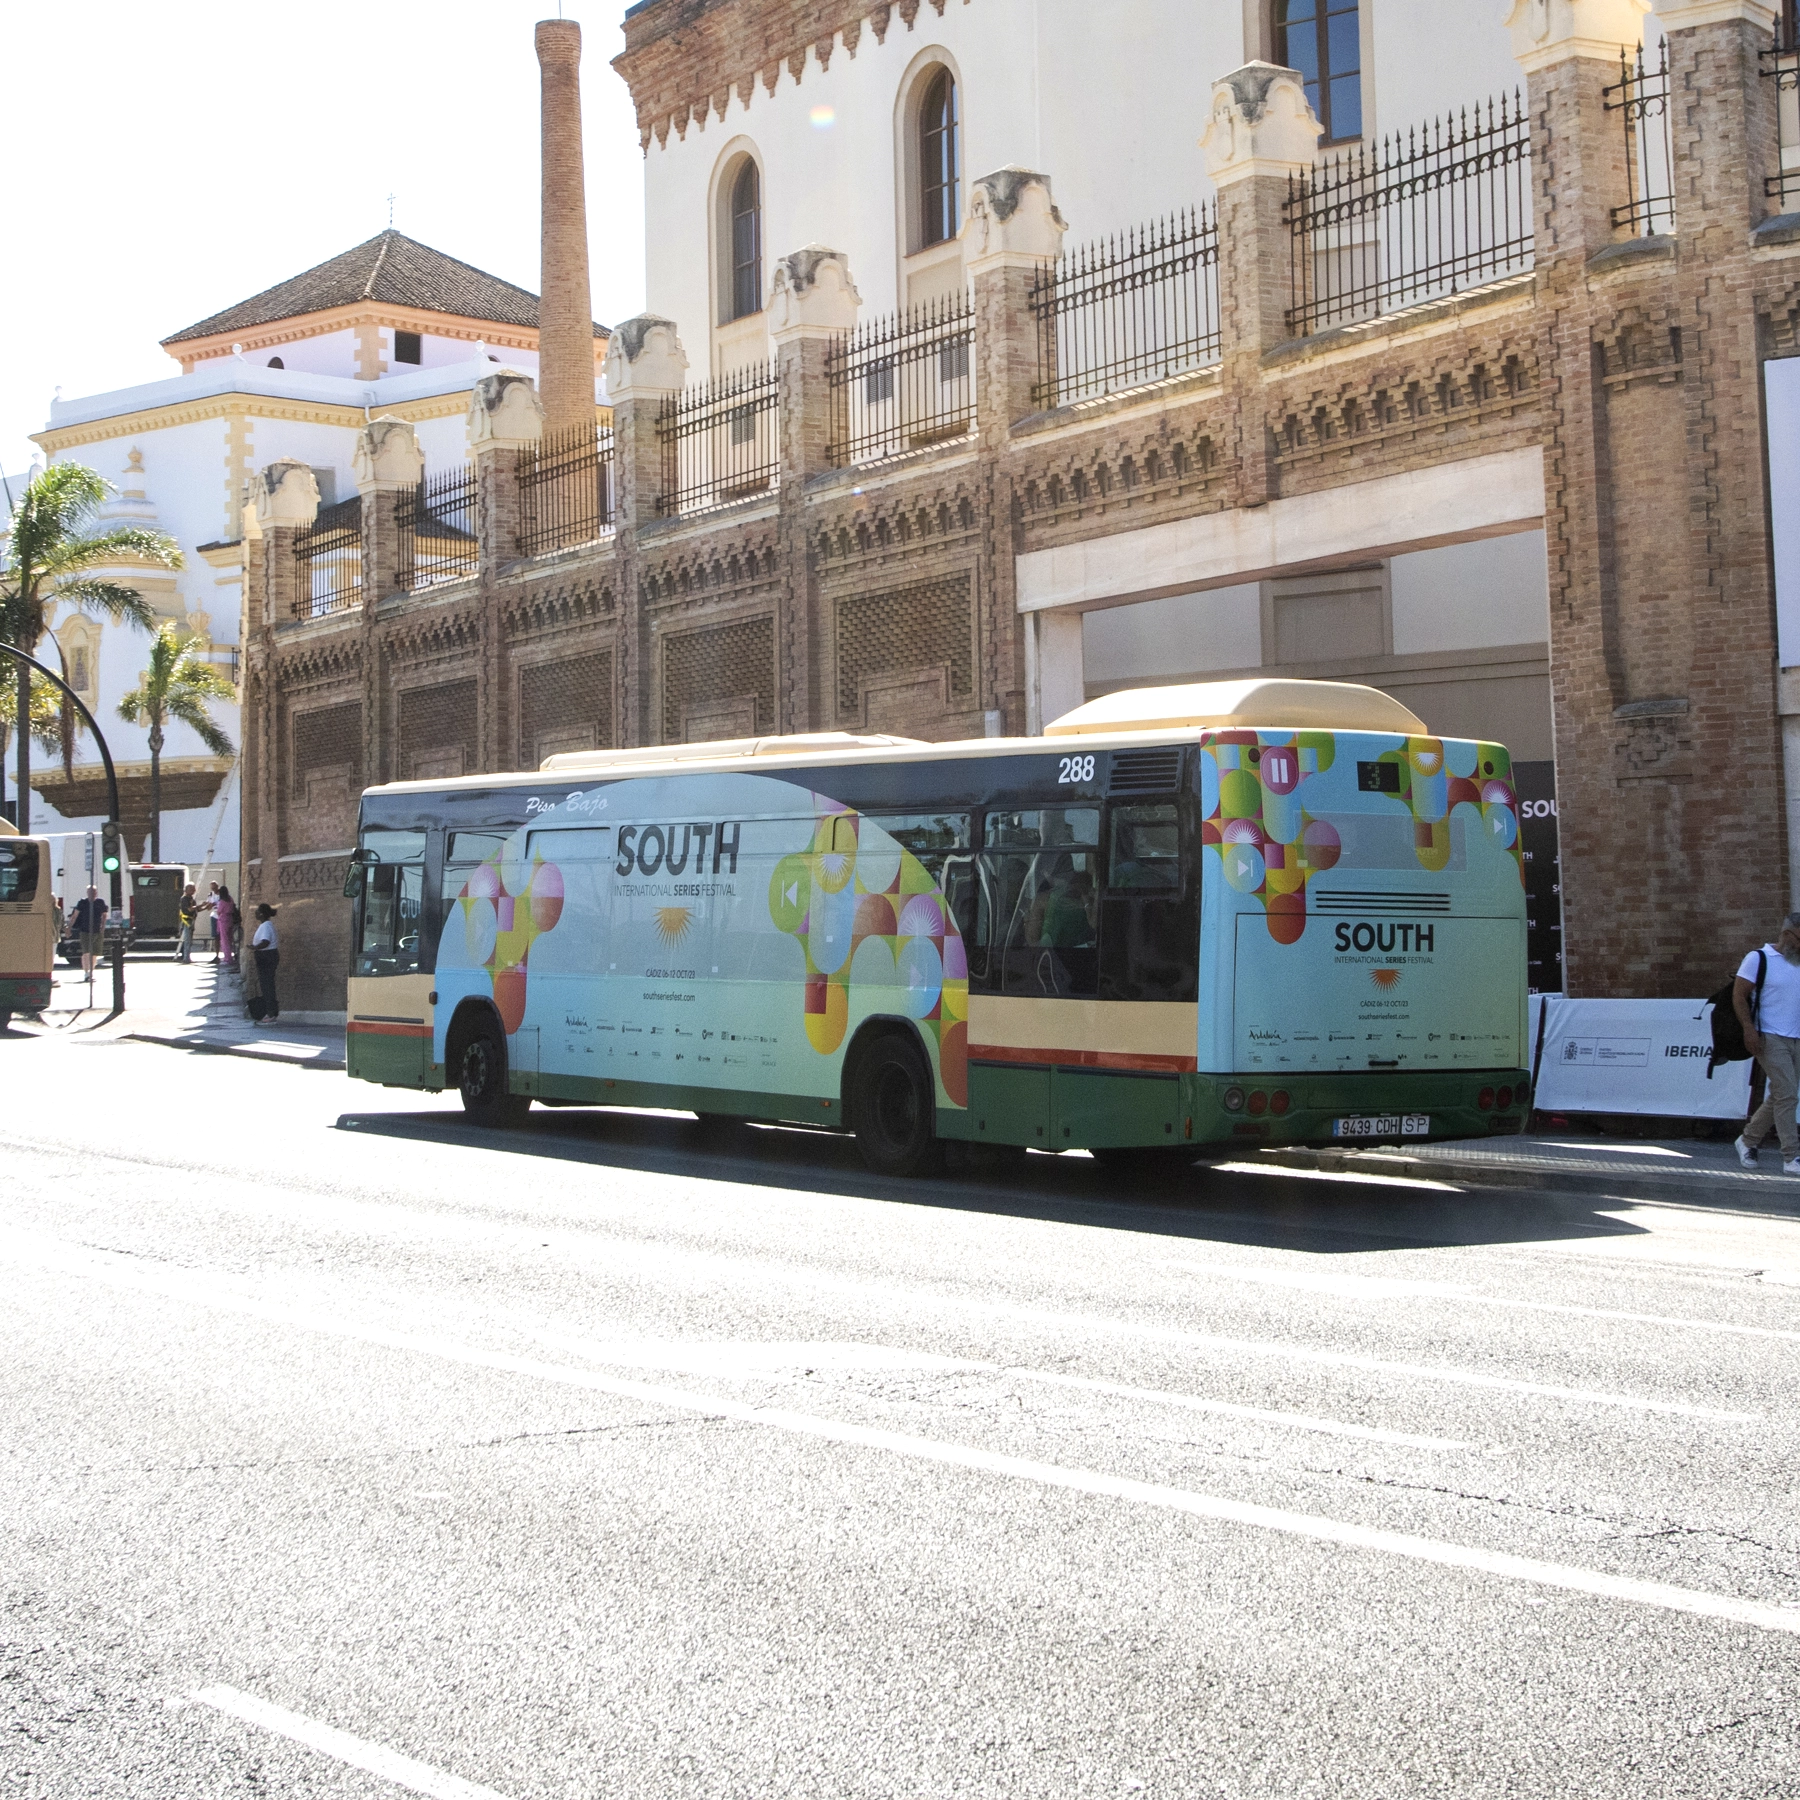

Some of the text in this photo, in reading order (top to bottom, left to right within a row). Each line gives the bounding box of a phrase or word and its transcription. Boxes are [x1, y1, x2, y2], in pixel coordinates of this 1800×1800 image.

[1058, 755, 1095, 784] 288
[1367, 762, 1380, 789] 3
[525, 791, 609, 816] Piso Bajo
[615, 823, 741, 876] SOUTH
[614, 883, 737, 897] INTERNATIONAL SERIES FESTIVAL
[1334, 922, 1434, 952] SOUTH
[1334, 956, 1434, 965] INTERNATIONAL SERIES FESTIVAL
[645, 968, 661, 978] CÁDIZ
[676, 970, 696, 979] OCT/23
[643, 991, 696, 1001] southseriesfest.com
[1360, 1000, 1376, 1008] CÁDIZ
[1358, 1012, 1410, 1021] southseriesfest.com
[1341, 1120, 1371, 1135] 9439
[1376, 1118, 1398, 1134] CDH
